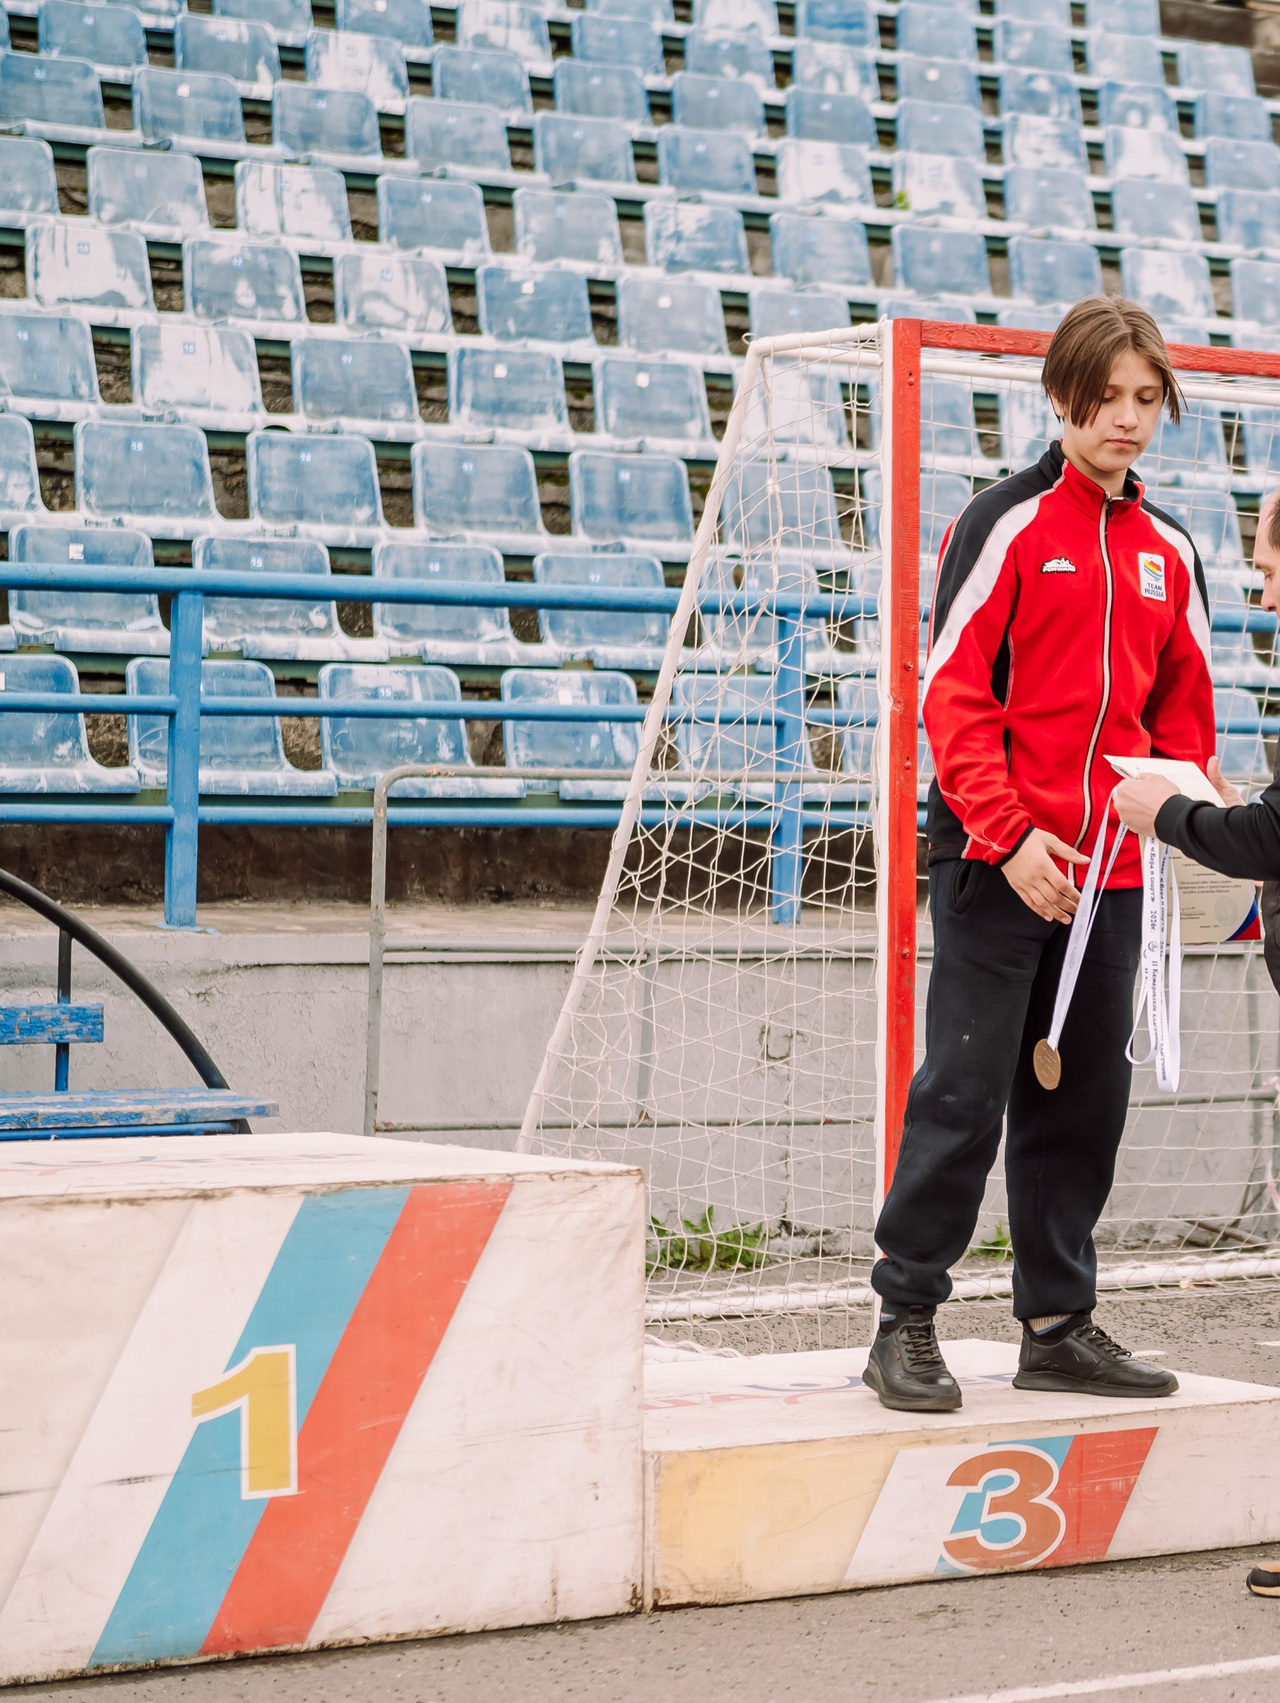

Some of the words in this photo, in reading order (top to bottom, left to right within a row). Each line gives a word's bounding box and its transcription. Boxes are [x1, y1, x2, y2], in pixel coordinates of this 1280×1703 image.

[1145, 588, 1165, 599] RUSSIA
[1147, 582, 1163, 591] TEAM
[191, 1344, 298, 1500] 1
[943, 1446, 1065, 1571] 3
